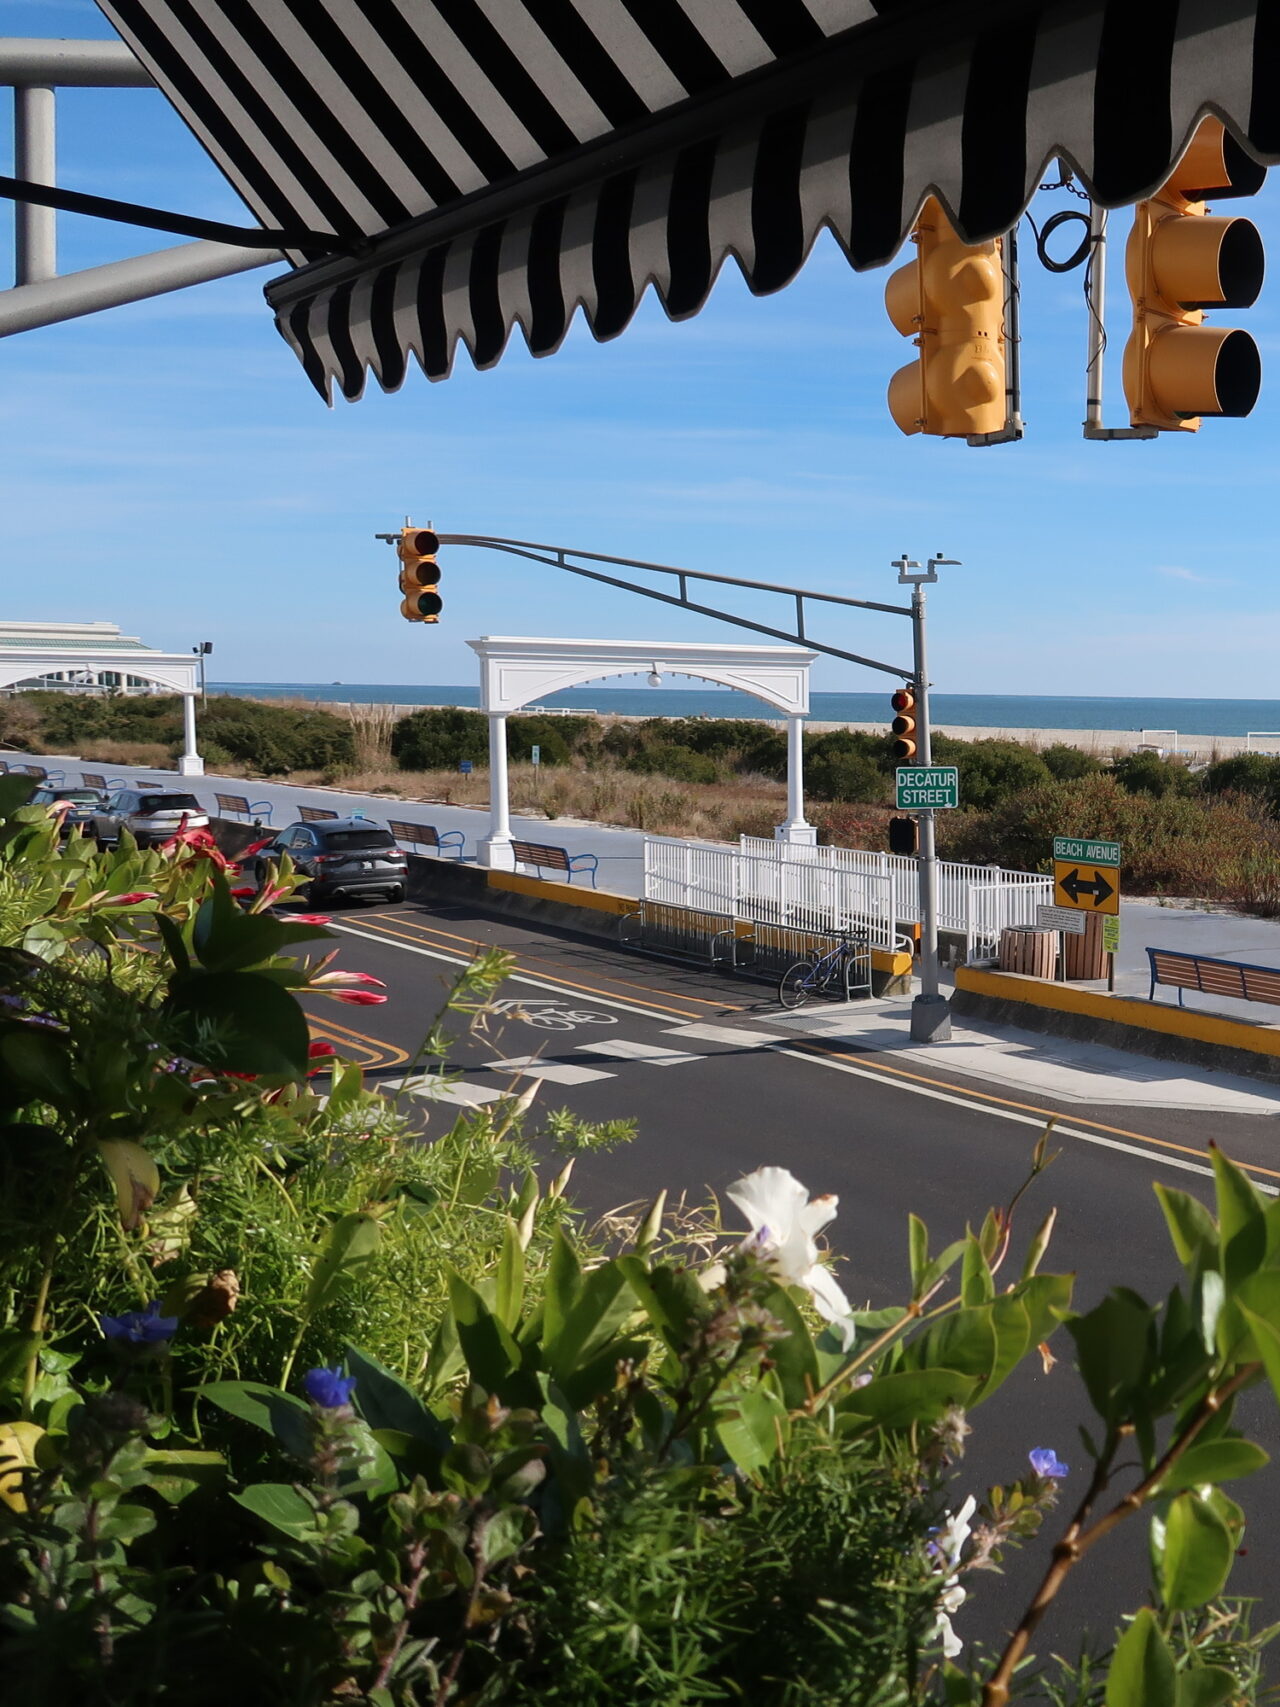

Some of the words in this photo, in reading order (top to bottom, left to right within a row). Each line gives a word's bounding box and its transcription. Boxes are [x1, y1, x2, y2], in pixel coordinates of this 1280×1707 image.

[898, 772, 956, 787] DECATUR
[902, 789, 952, 804] STREET
[1055, 841, 1083, 857] BEACH
[1085, 845, 1118, 861] AVENUE
